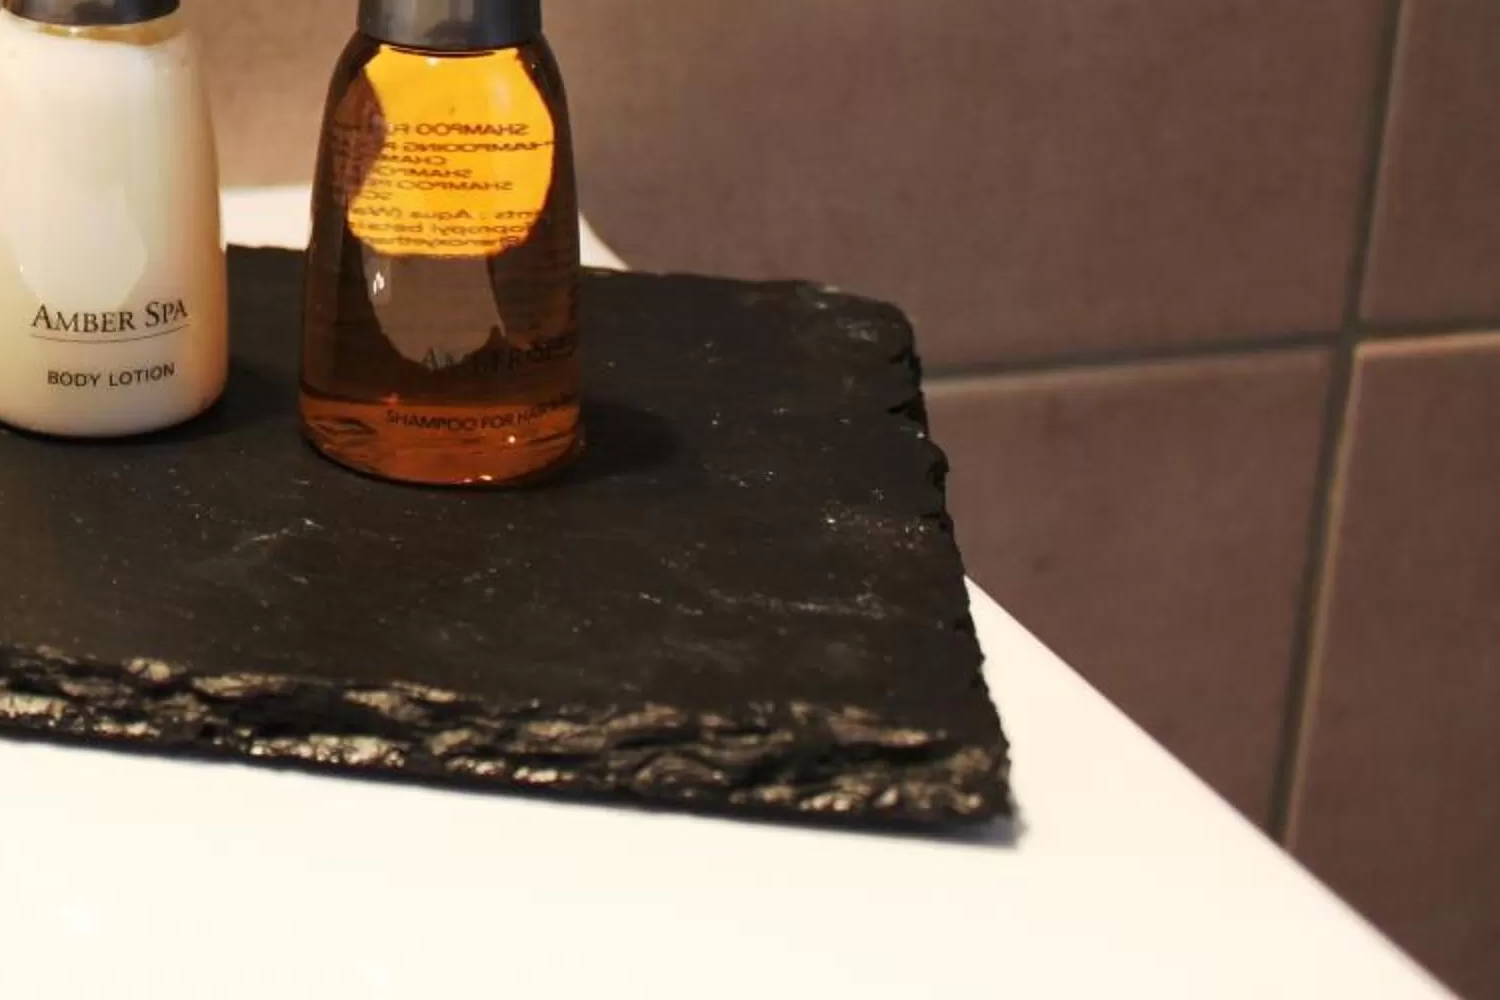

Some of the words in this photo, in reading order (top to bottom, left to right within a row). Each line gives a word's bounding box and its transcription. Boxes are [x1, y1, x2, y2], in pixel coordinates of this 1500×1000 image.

[30, 302, 136, 334] AMBER
[144, 299, 189, 329] SPA
[47, 369, 101, 388] BODY
[108, 362, 176, 388] LOTION
[385, 409, 478, 432] SHAMPOO
[481, 412, 514, 430] FOR
